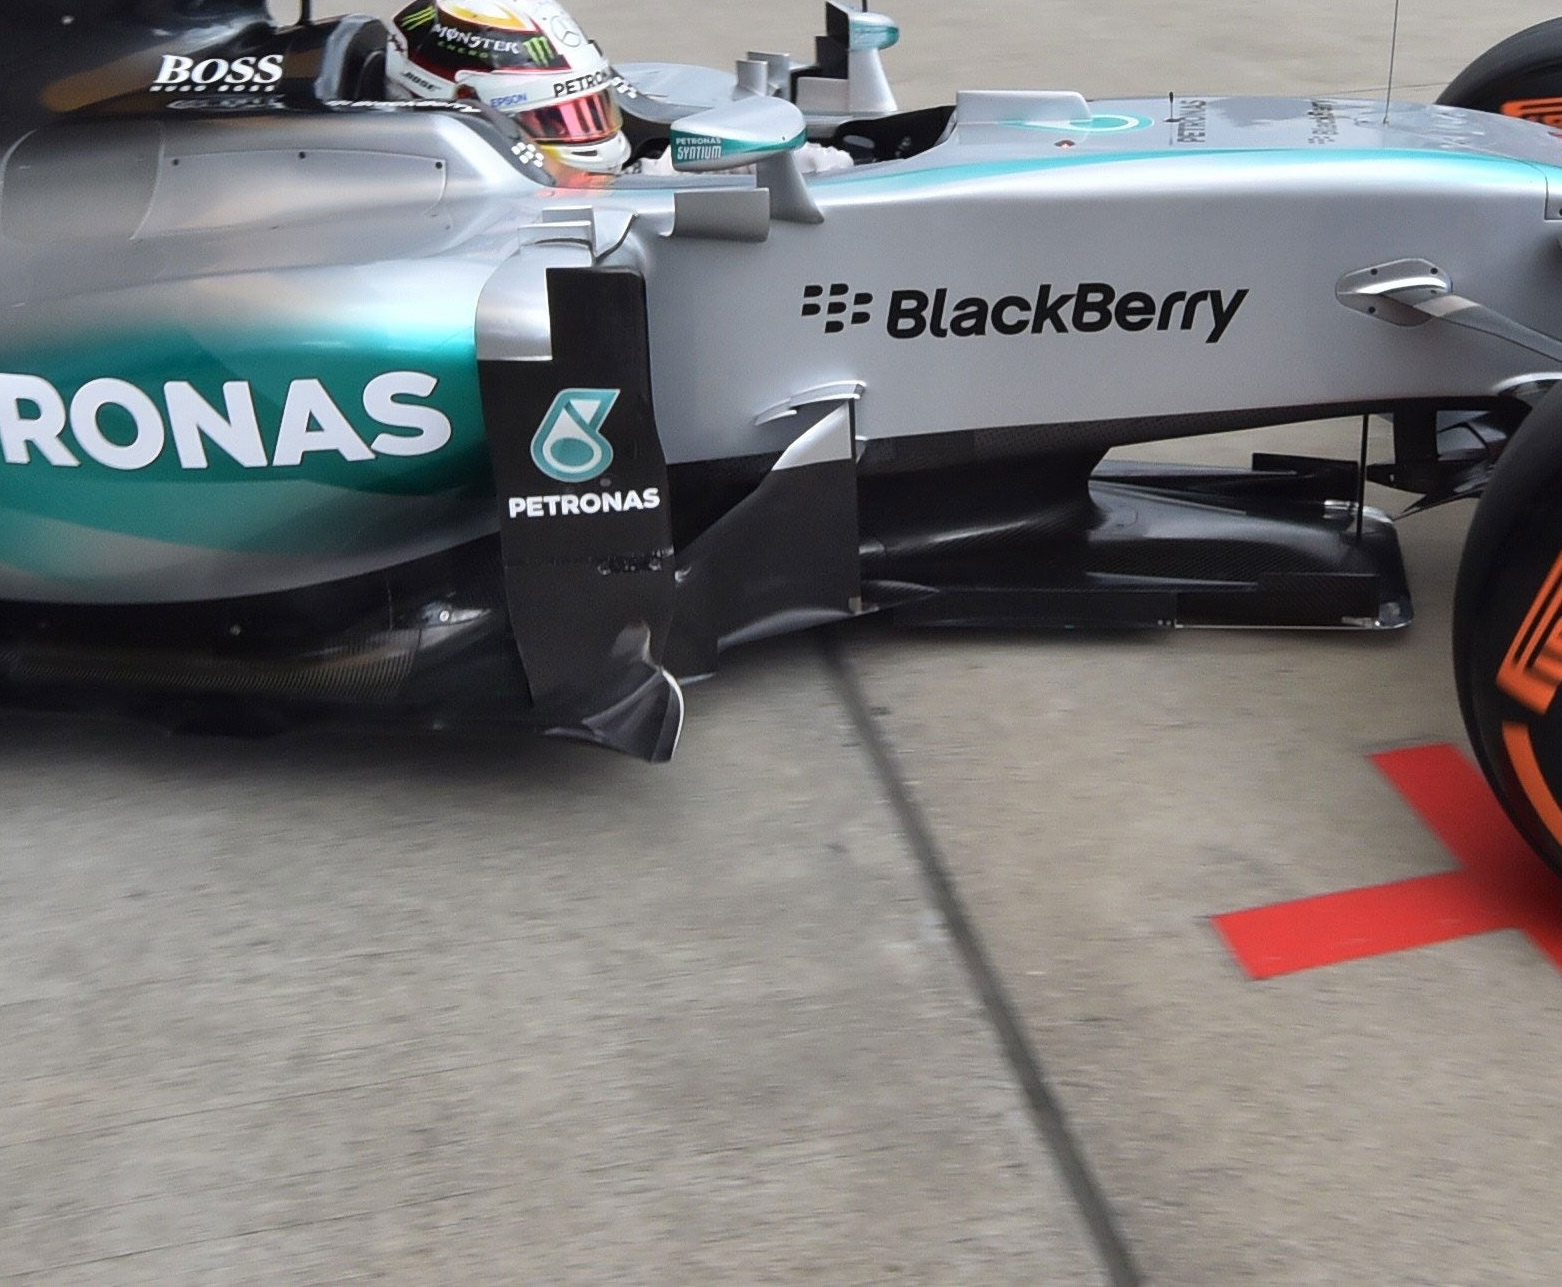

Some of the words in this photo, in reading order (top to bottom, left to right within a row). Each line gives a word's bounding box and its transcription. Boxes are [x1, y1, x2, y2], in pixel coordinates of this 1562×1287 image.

[153, 54, 284, 84] BOSS
[490, 93, 527, 108] EPSON
[675, 136, 722, 145] PETRONAS
[676, 145, 722, 160] SYNTIUM
[885, 281, 1250, 344] BlackBerry
[508, 487, 661, 519] PETRONAS
